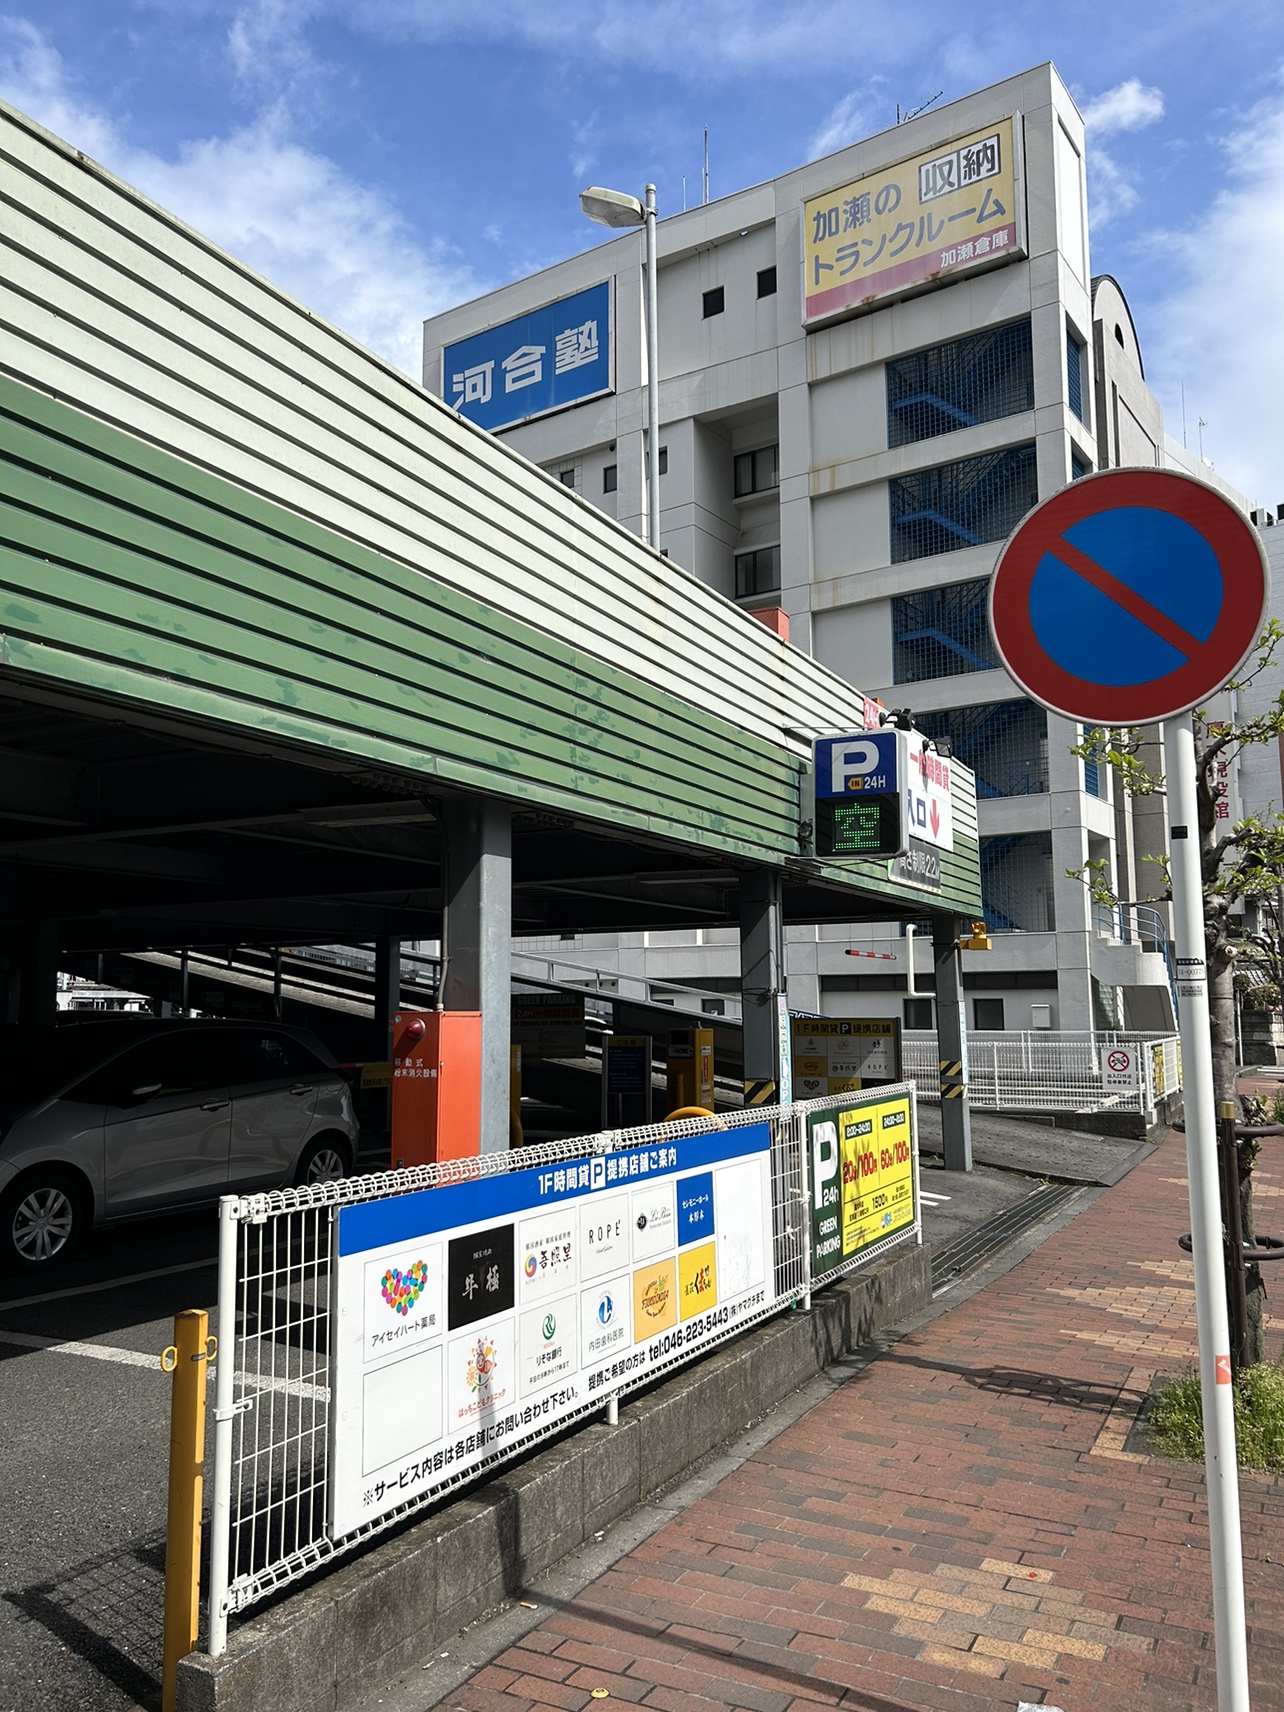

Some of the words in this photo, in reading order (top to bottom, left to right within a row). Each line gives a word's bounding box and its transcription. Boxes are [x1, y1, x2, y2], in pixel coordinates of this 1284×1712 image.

[812, 183, 902, 245] 加瀬の
[922, 140, 999, 195] 収納
[814, 187, 1006, 286] トランクルーム
[940, 230, 1009, 269] 加瀬倉庫
[452, 320, 599, 411] 河合塾
[831, 740, 880, 793] P
[851, 779, 861, 788] IN
[864, 775, 886, 789] 24H
[835, 803, 880, 849] 空
[517, 996, 540, 1006] GREEN
[543, 994, 576, 1005] PARKING
[394, 1057, 424, 1068] 移動式
[394, 1068, 437, 1078] 粉末消火設備
[812, 1121, 838, 1210] P
[682, 1194, 709, 1209] セレモニーホール
[823, 1186, 839, 1208] 24h
[819, 1216, 838, 1237] GREEN
[816, 1235, 841, 1259] PARKING
[372, 1313, 436, 1347] アイセイハート薬局
[589, 1327, 624, 1352] 内田歯科医院
[536, 1346, 562, 1366] りそな銀行
[588, 1350, 645, 1391] 提携ご希望の方は
